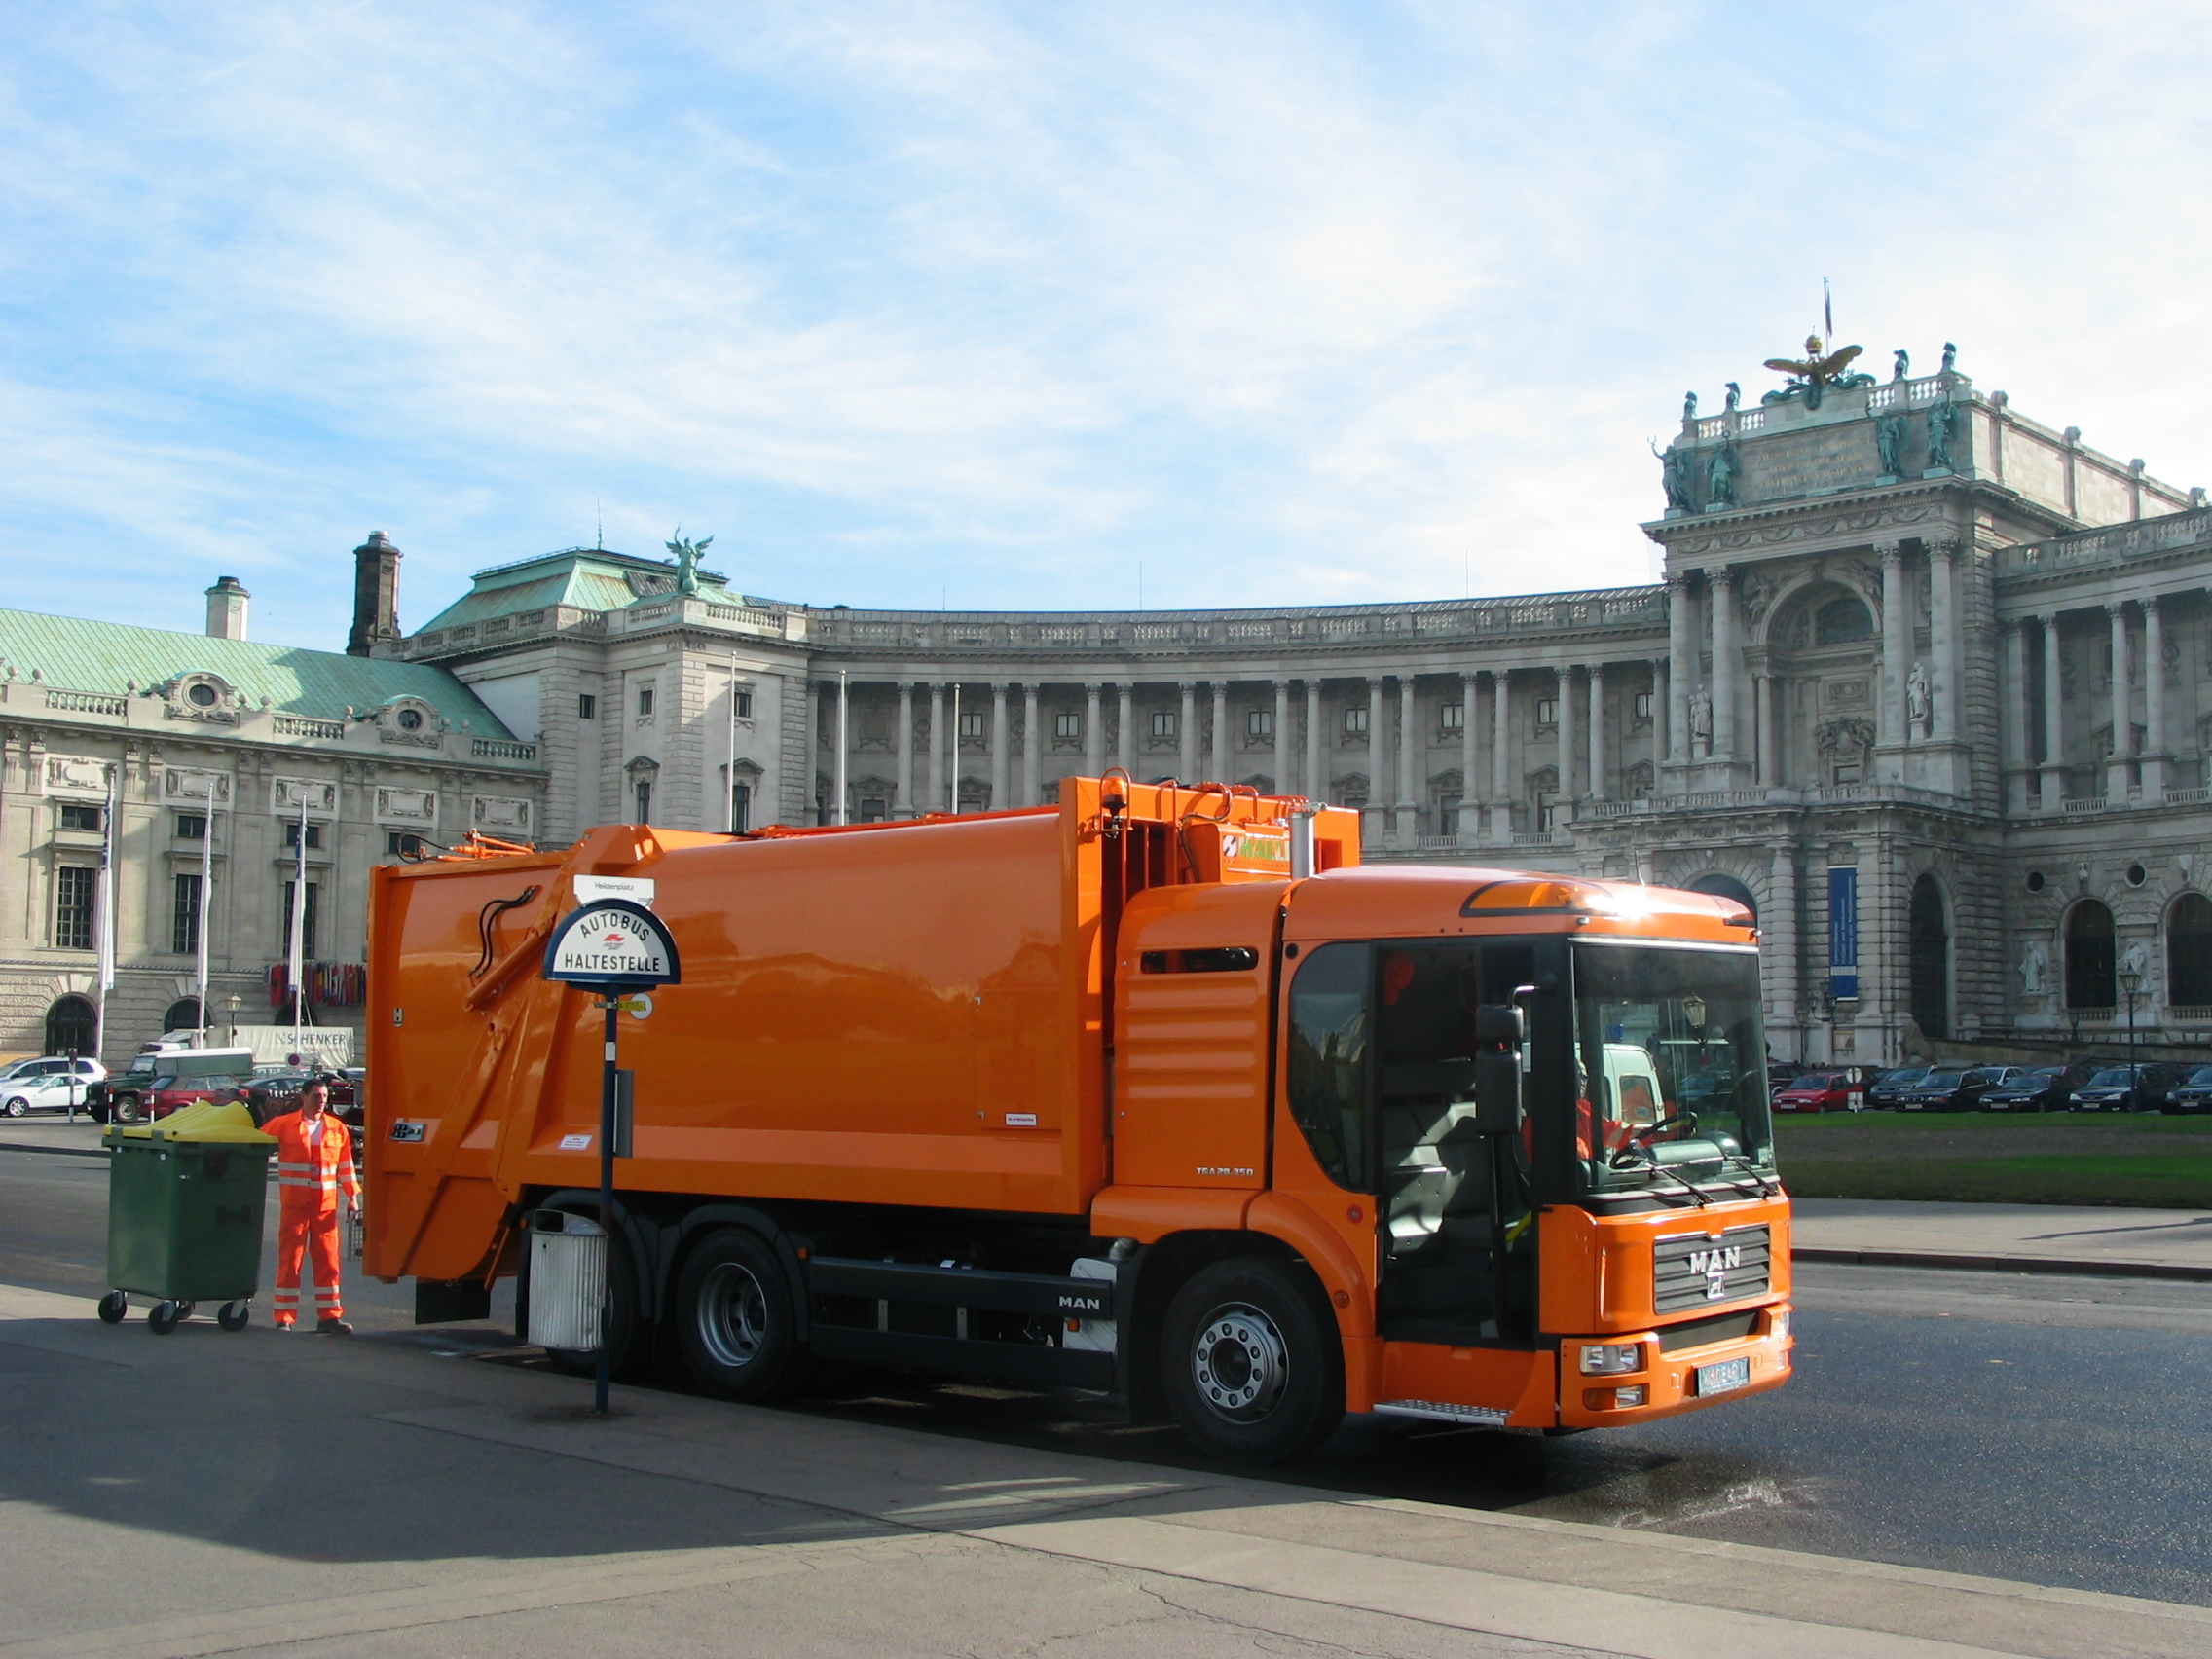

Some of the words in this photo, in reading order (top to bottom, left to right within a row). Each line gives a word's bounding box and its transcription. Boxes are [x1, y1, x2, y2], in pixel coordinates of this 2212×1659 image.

[594, 882, 635, 892] Heldenplatz
[579, 912, 650, 942] AUTOBUS
[565, 953, 660, 972] HALTESTELLE
[1689, 1246, 1741, 1274] MAN
[1058, 1296, 1100, 1309] MAN
